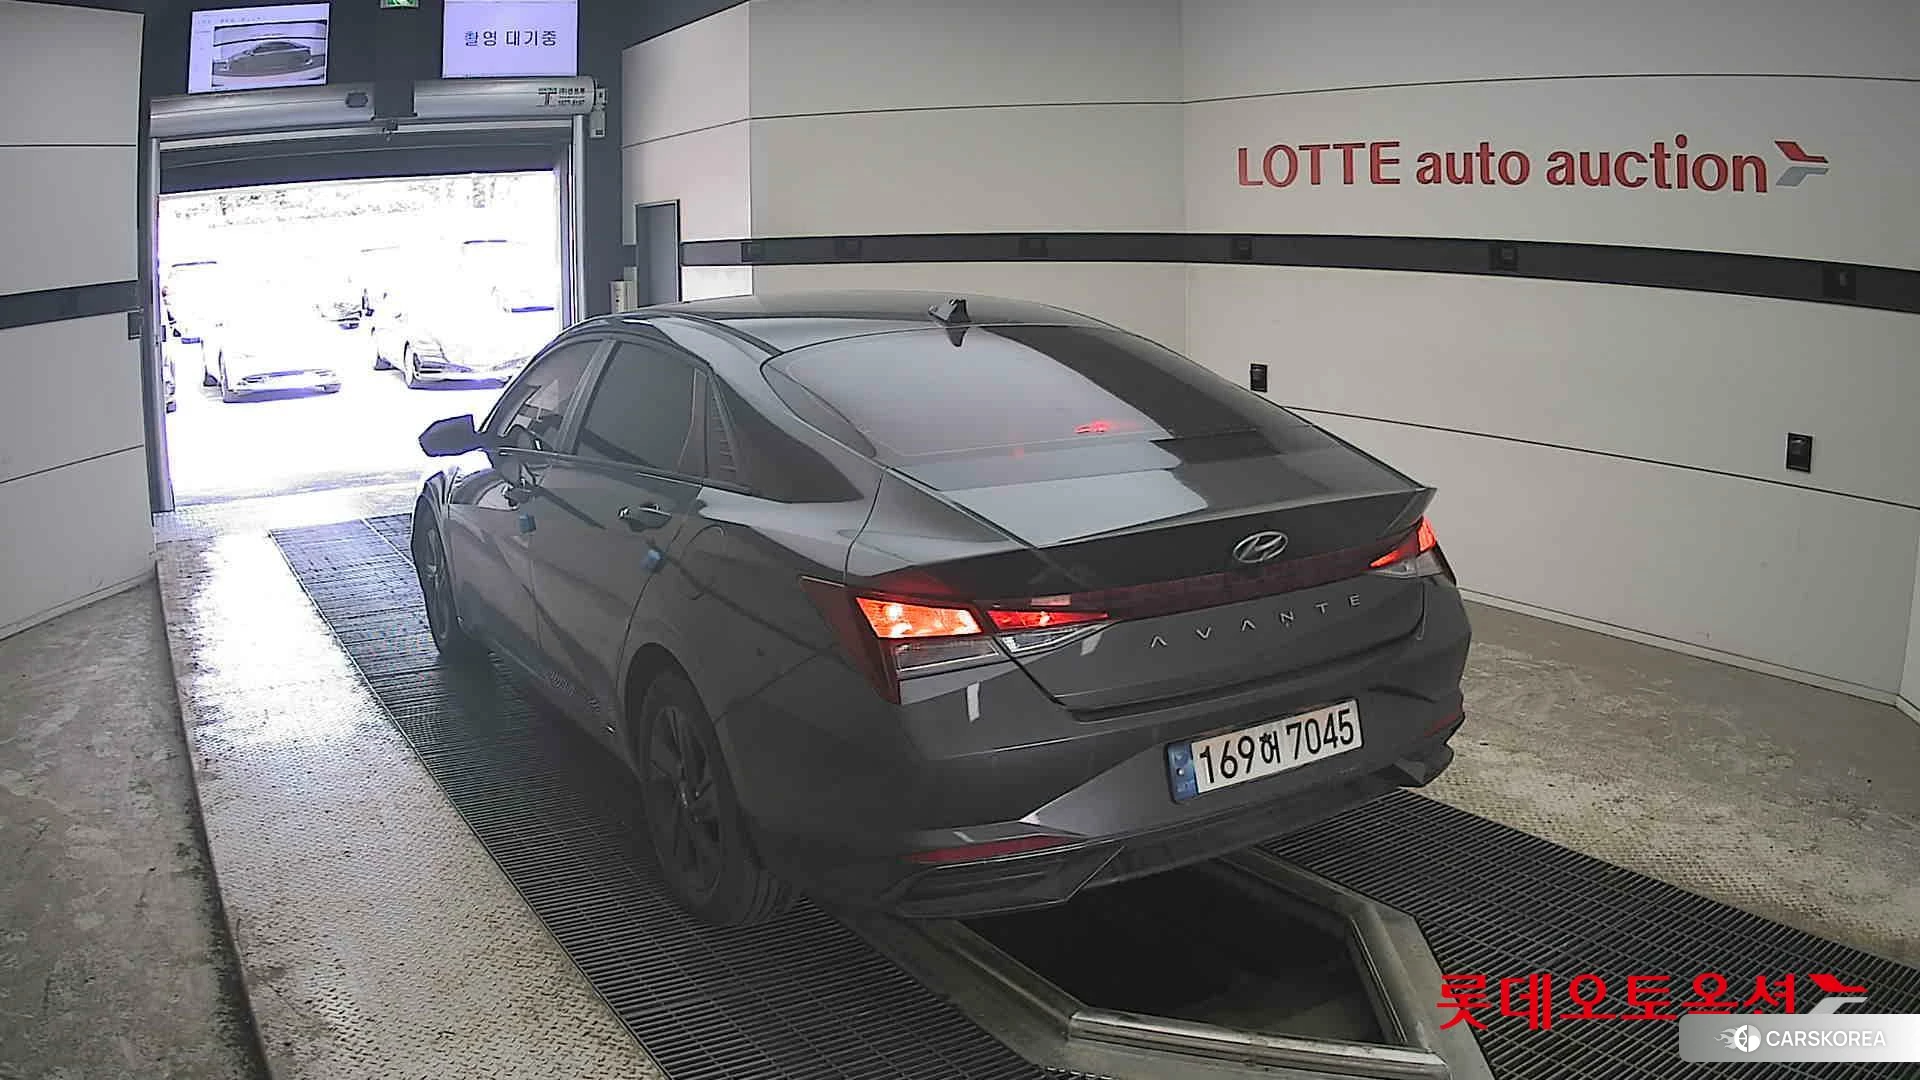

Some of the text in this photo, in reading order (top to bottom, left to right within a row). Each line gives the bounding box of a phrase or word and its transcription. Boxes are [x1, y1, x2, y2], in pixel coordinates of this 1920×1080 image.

[505, 30, 558, 47] 대기중
[1238, 134, 1768, 193] LOTTE auto auction
[1150, 593, 1361, 648] AVANTE
